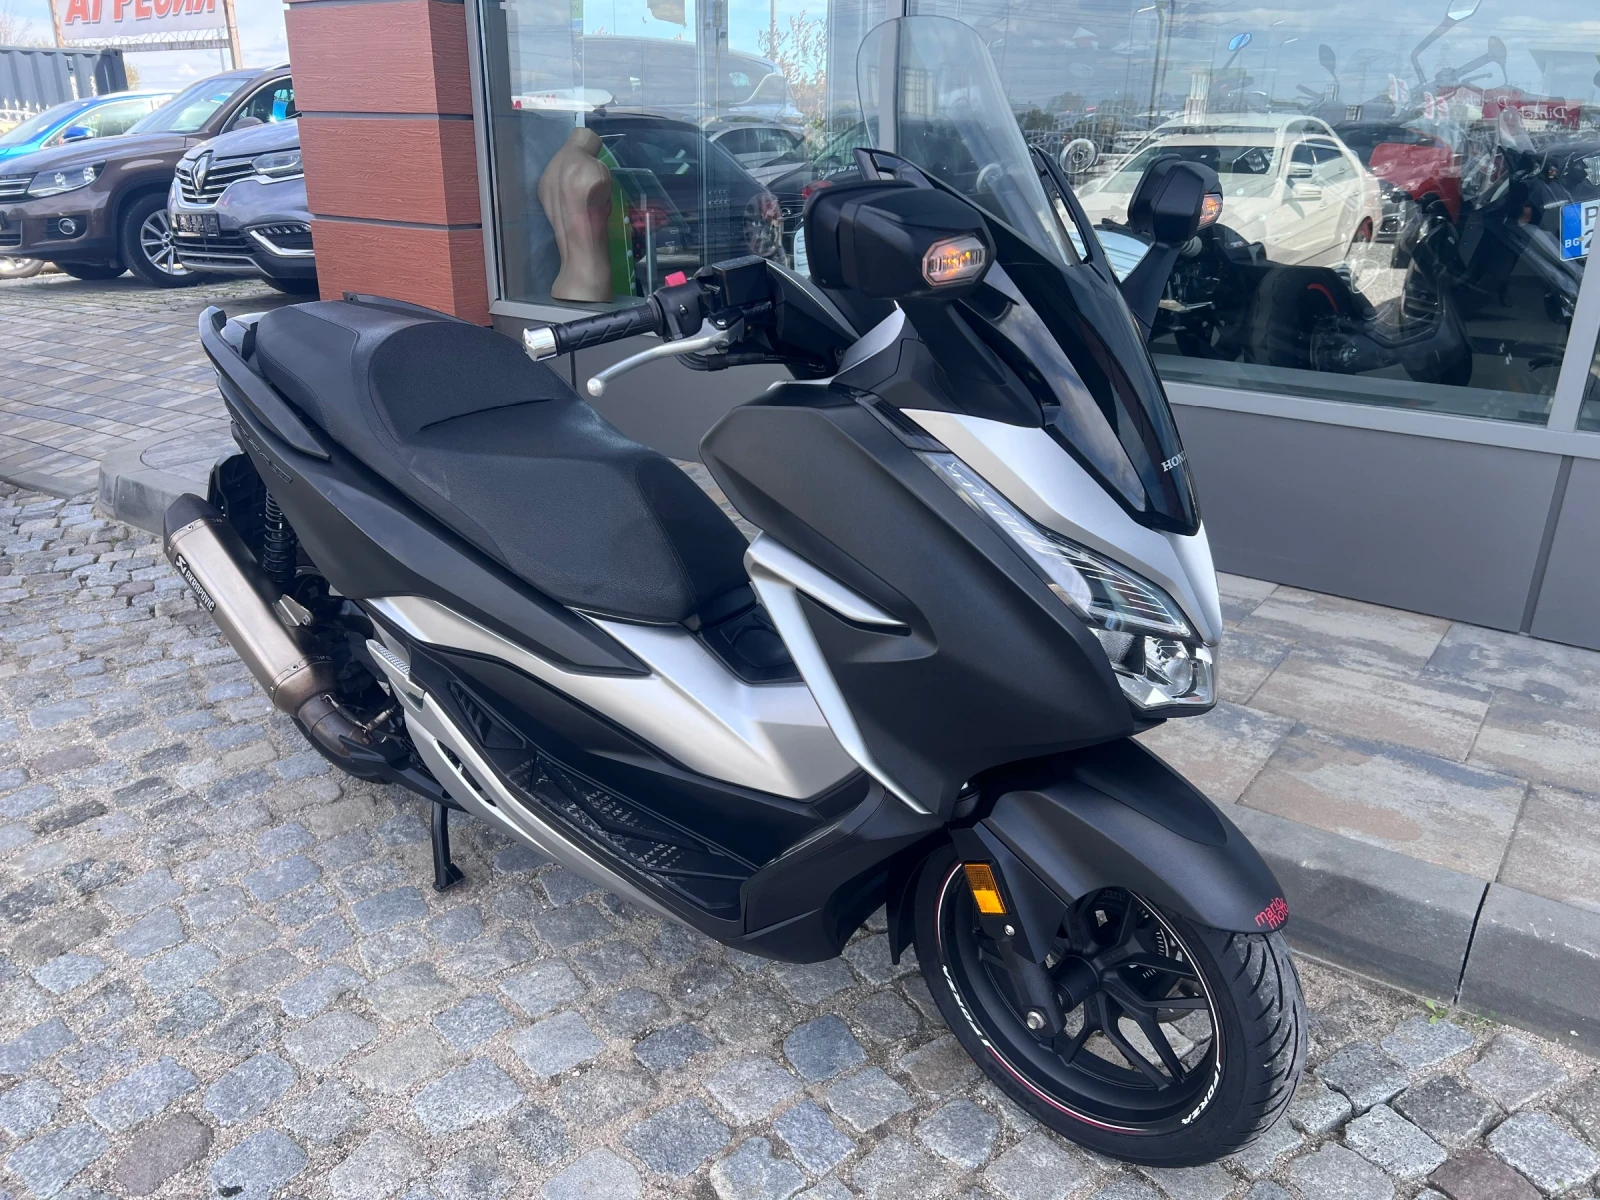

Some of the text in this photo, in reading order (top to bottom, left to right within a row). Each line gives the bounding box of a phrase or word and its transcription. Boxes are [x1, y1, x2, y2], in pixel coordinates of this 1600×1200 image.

[1564, 237, 1580, 248] BG
[1254, 897, 1282, 927] mario
[1181, 1069, 1220, 1125] FORZA
